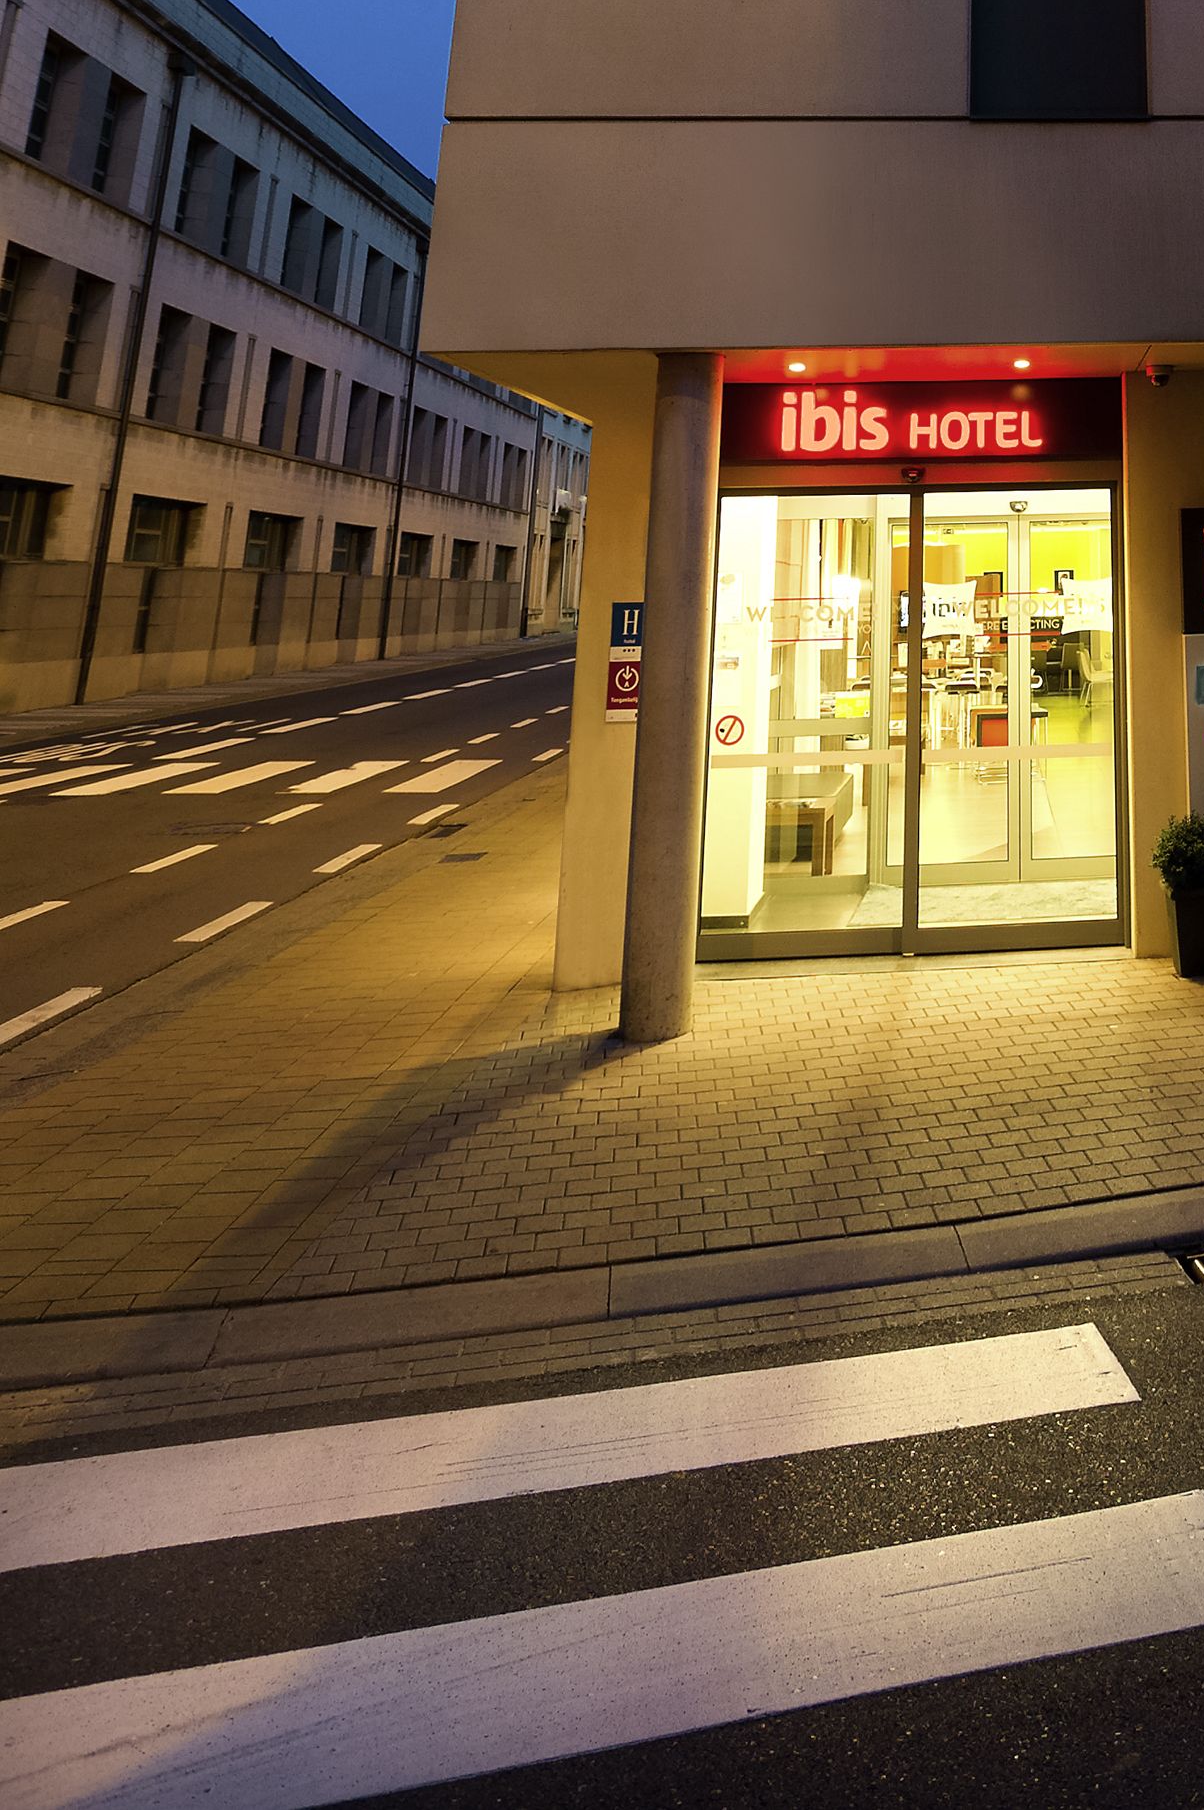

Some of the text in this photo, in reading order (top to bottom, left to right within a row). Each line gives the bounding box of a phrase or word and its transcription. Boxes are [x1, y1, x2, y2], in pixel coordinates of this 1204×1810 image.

[781, 390, 1043, 453] ibis HOTEL
[622, 609, 640, 636] H
[1002, 619, 1060, 631] ECTING
